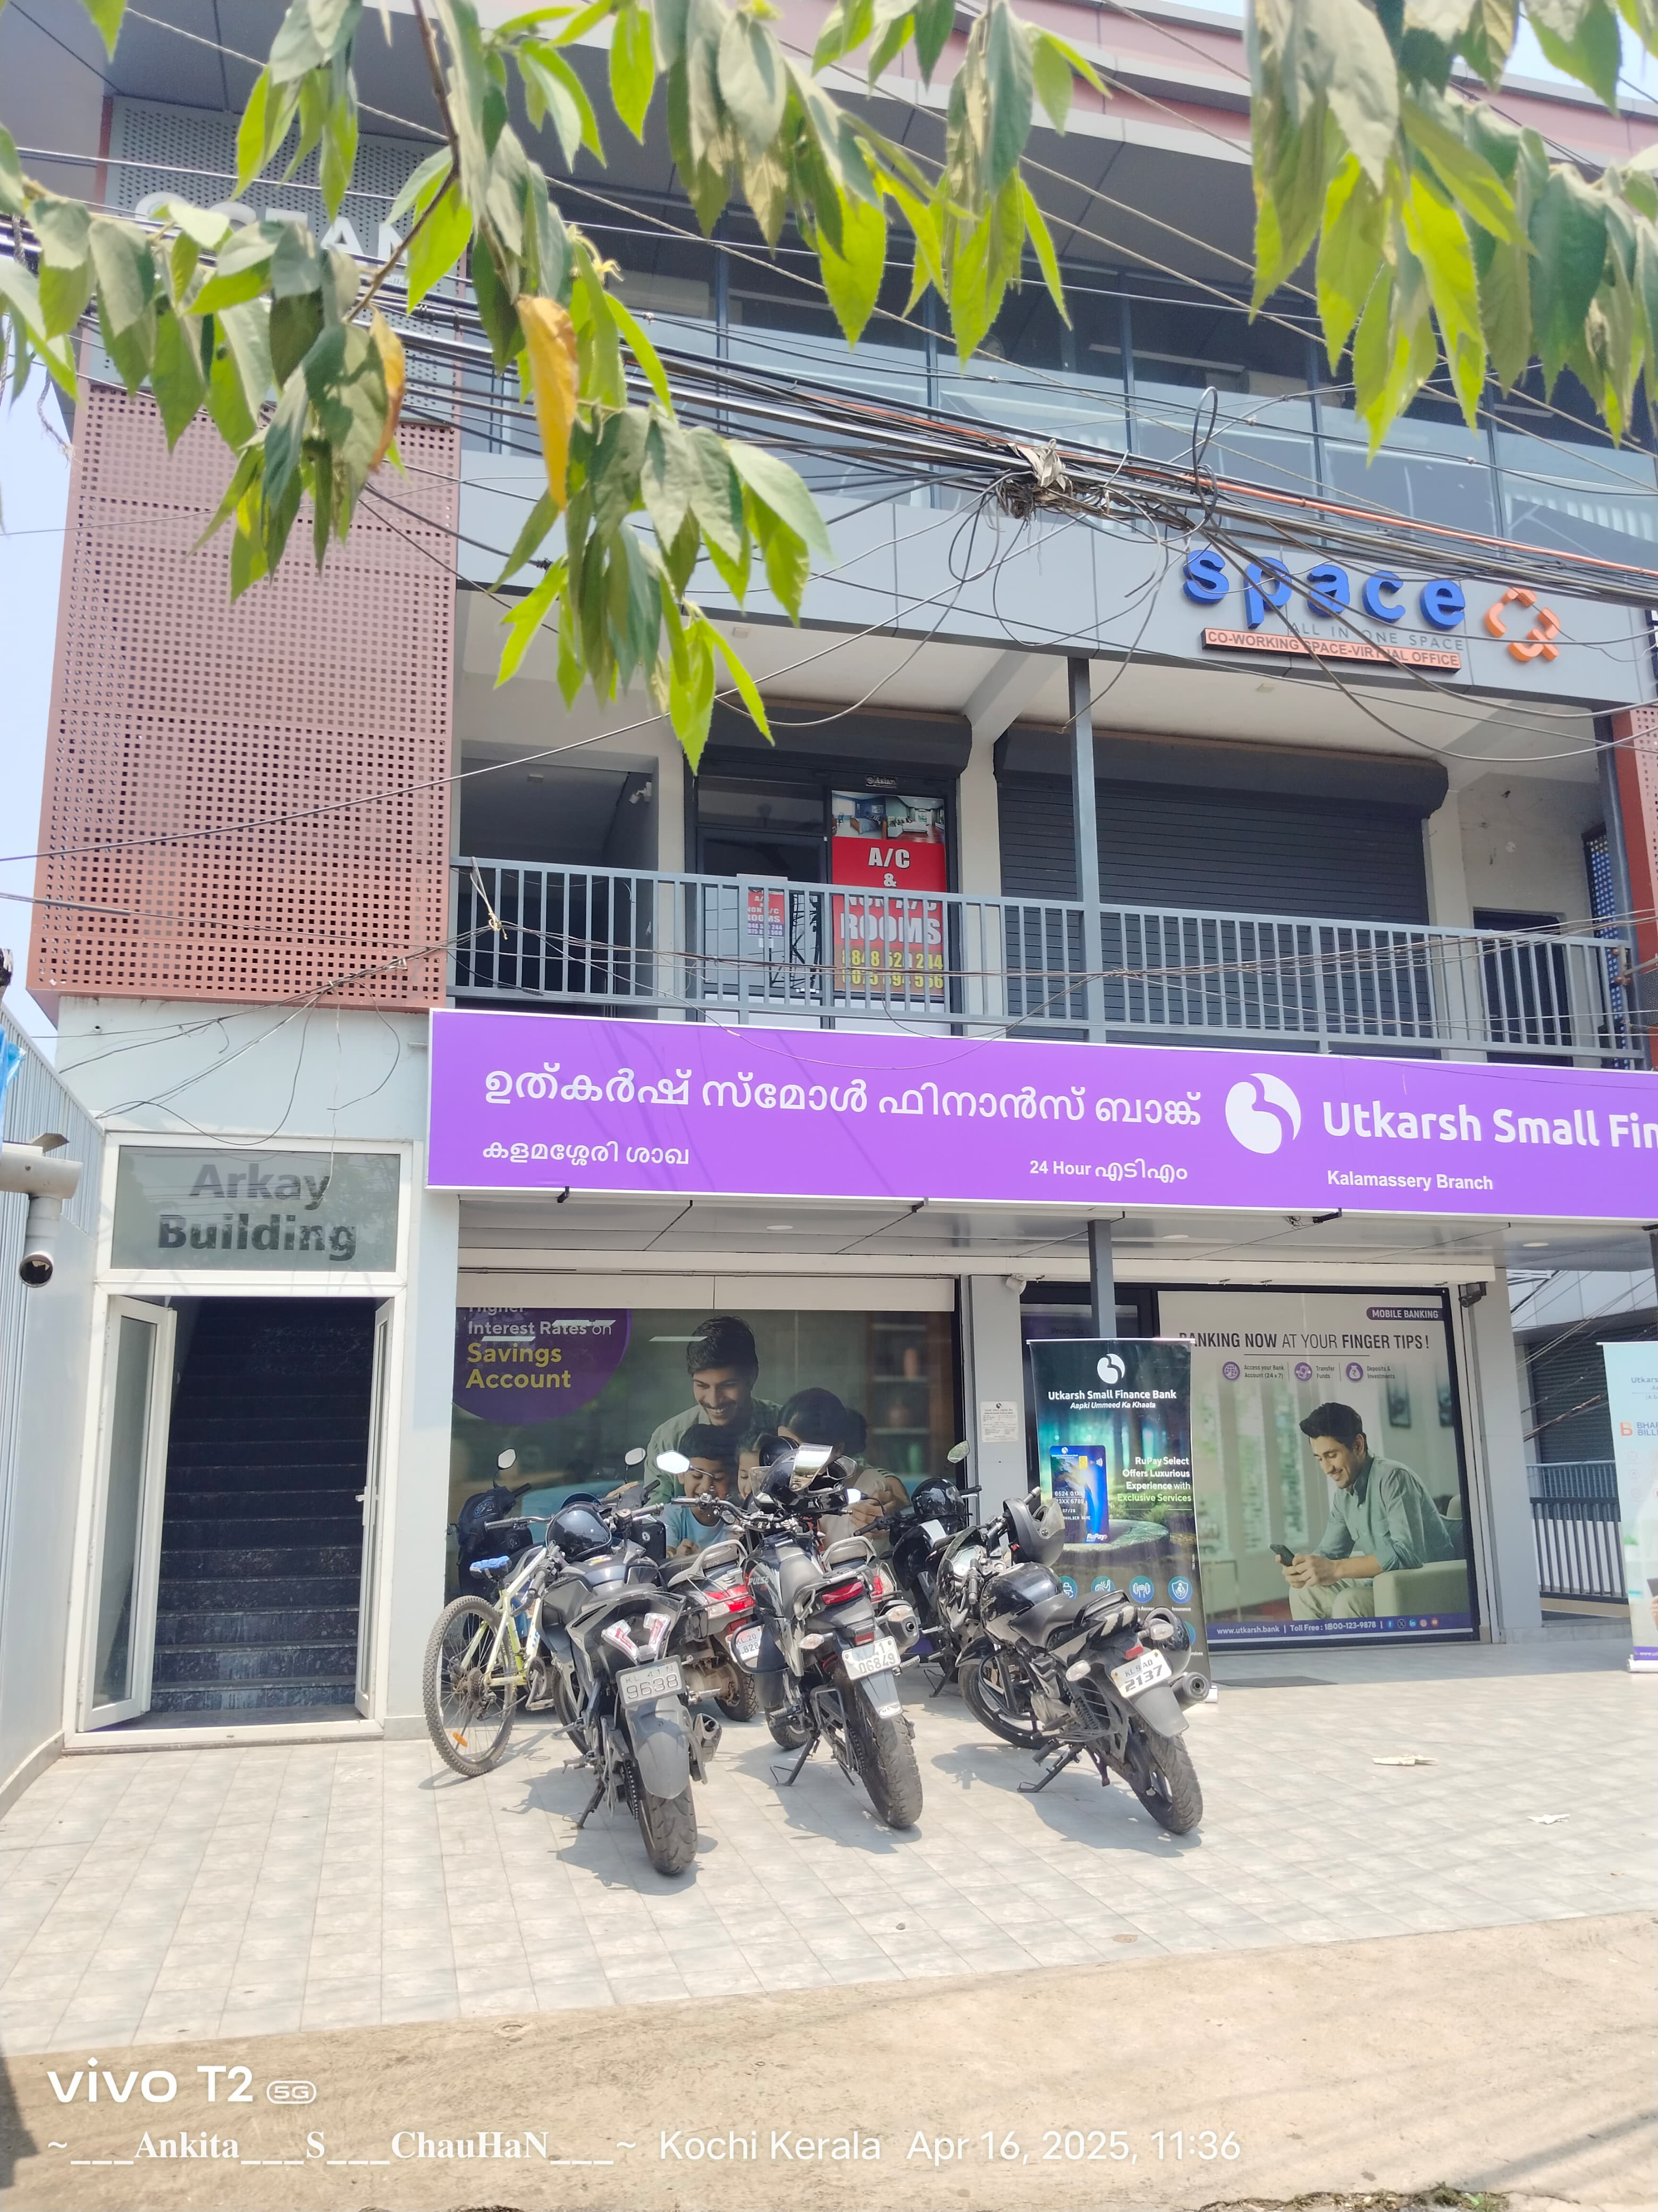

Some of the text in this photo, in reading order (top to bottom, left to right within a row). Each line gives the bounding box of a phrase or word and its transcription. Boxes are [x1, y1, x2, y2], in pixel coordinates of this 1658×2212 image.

[1182, 549, 1466, 630] space
[1208, 631, 1299, 650] CO-WORKING
[1412, 651, 1459, 666] OFFICE
[1290, 623, 1464, 651] ALL IN ONE SPACE
[868, 848, 910, 868] A/C
[883, 873, 897, 887] &
[840, 912, 941, 945] ROOMS
[1095, 1092, 1201, 1125] ബാങ്ക്
[1323, 1101, 1482, 1141] Utkarsh
[1493, 1109, 1600, 1146] Small
[626, 1145, 689, 1164] ശാഖ
[1030, 1158, 1188, 1183] 24 Hour എടിഎം
[1327, 1170, 1493, 1191] Kalamassery Branch
[189, 1163, 332, 1210] Arkay
[158, 1213, 357, 1261] Building
[1372, 1309, 1438, 1319] MOBILE BANKING
[468, 1321, 611, 1335] Interest Rates on
[1245, 1333, 1277, 1347] NOW
[1282, 1334, 1297, 1348] AT
[1301, 1334, 1337, 1348] YOUR
[1342, 1335, 1390, 1348] FINGER
[467, 1343, 562, 1368] Savings
[465, 1368, 571, 1388] Account
[1048, 1389, 1176, 1400] Utkarsh Small Finance Bank
[1135, 1456, 1190, 1467] RuPay Select
[1126, 1481, 1172, 1491] Experience
[1217, 1625, 1280, 1634] www.utkarsh.bank
[1324, 1621, 1376, 1630] 1800-123-9878
[626, 1673, 678, 1699] 9638
[1125, 1665, 1163, 1692] 2137
